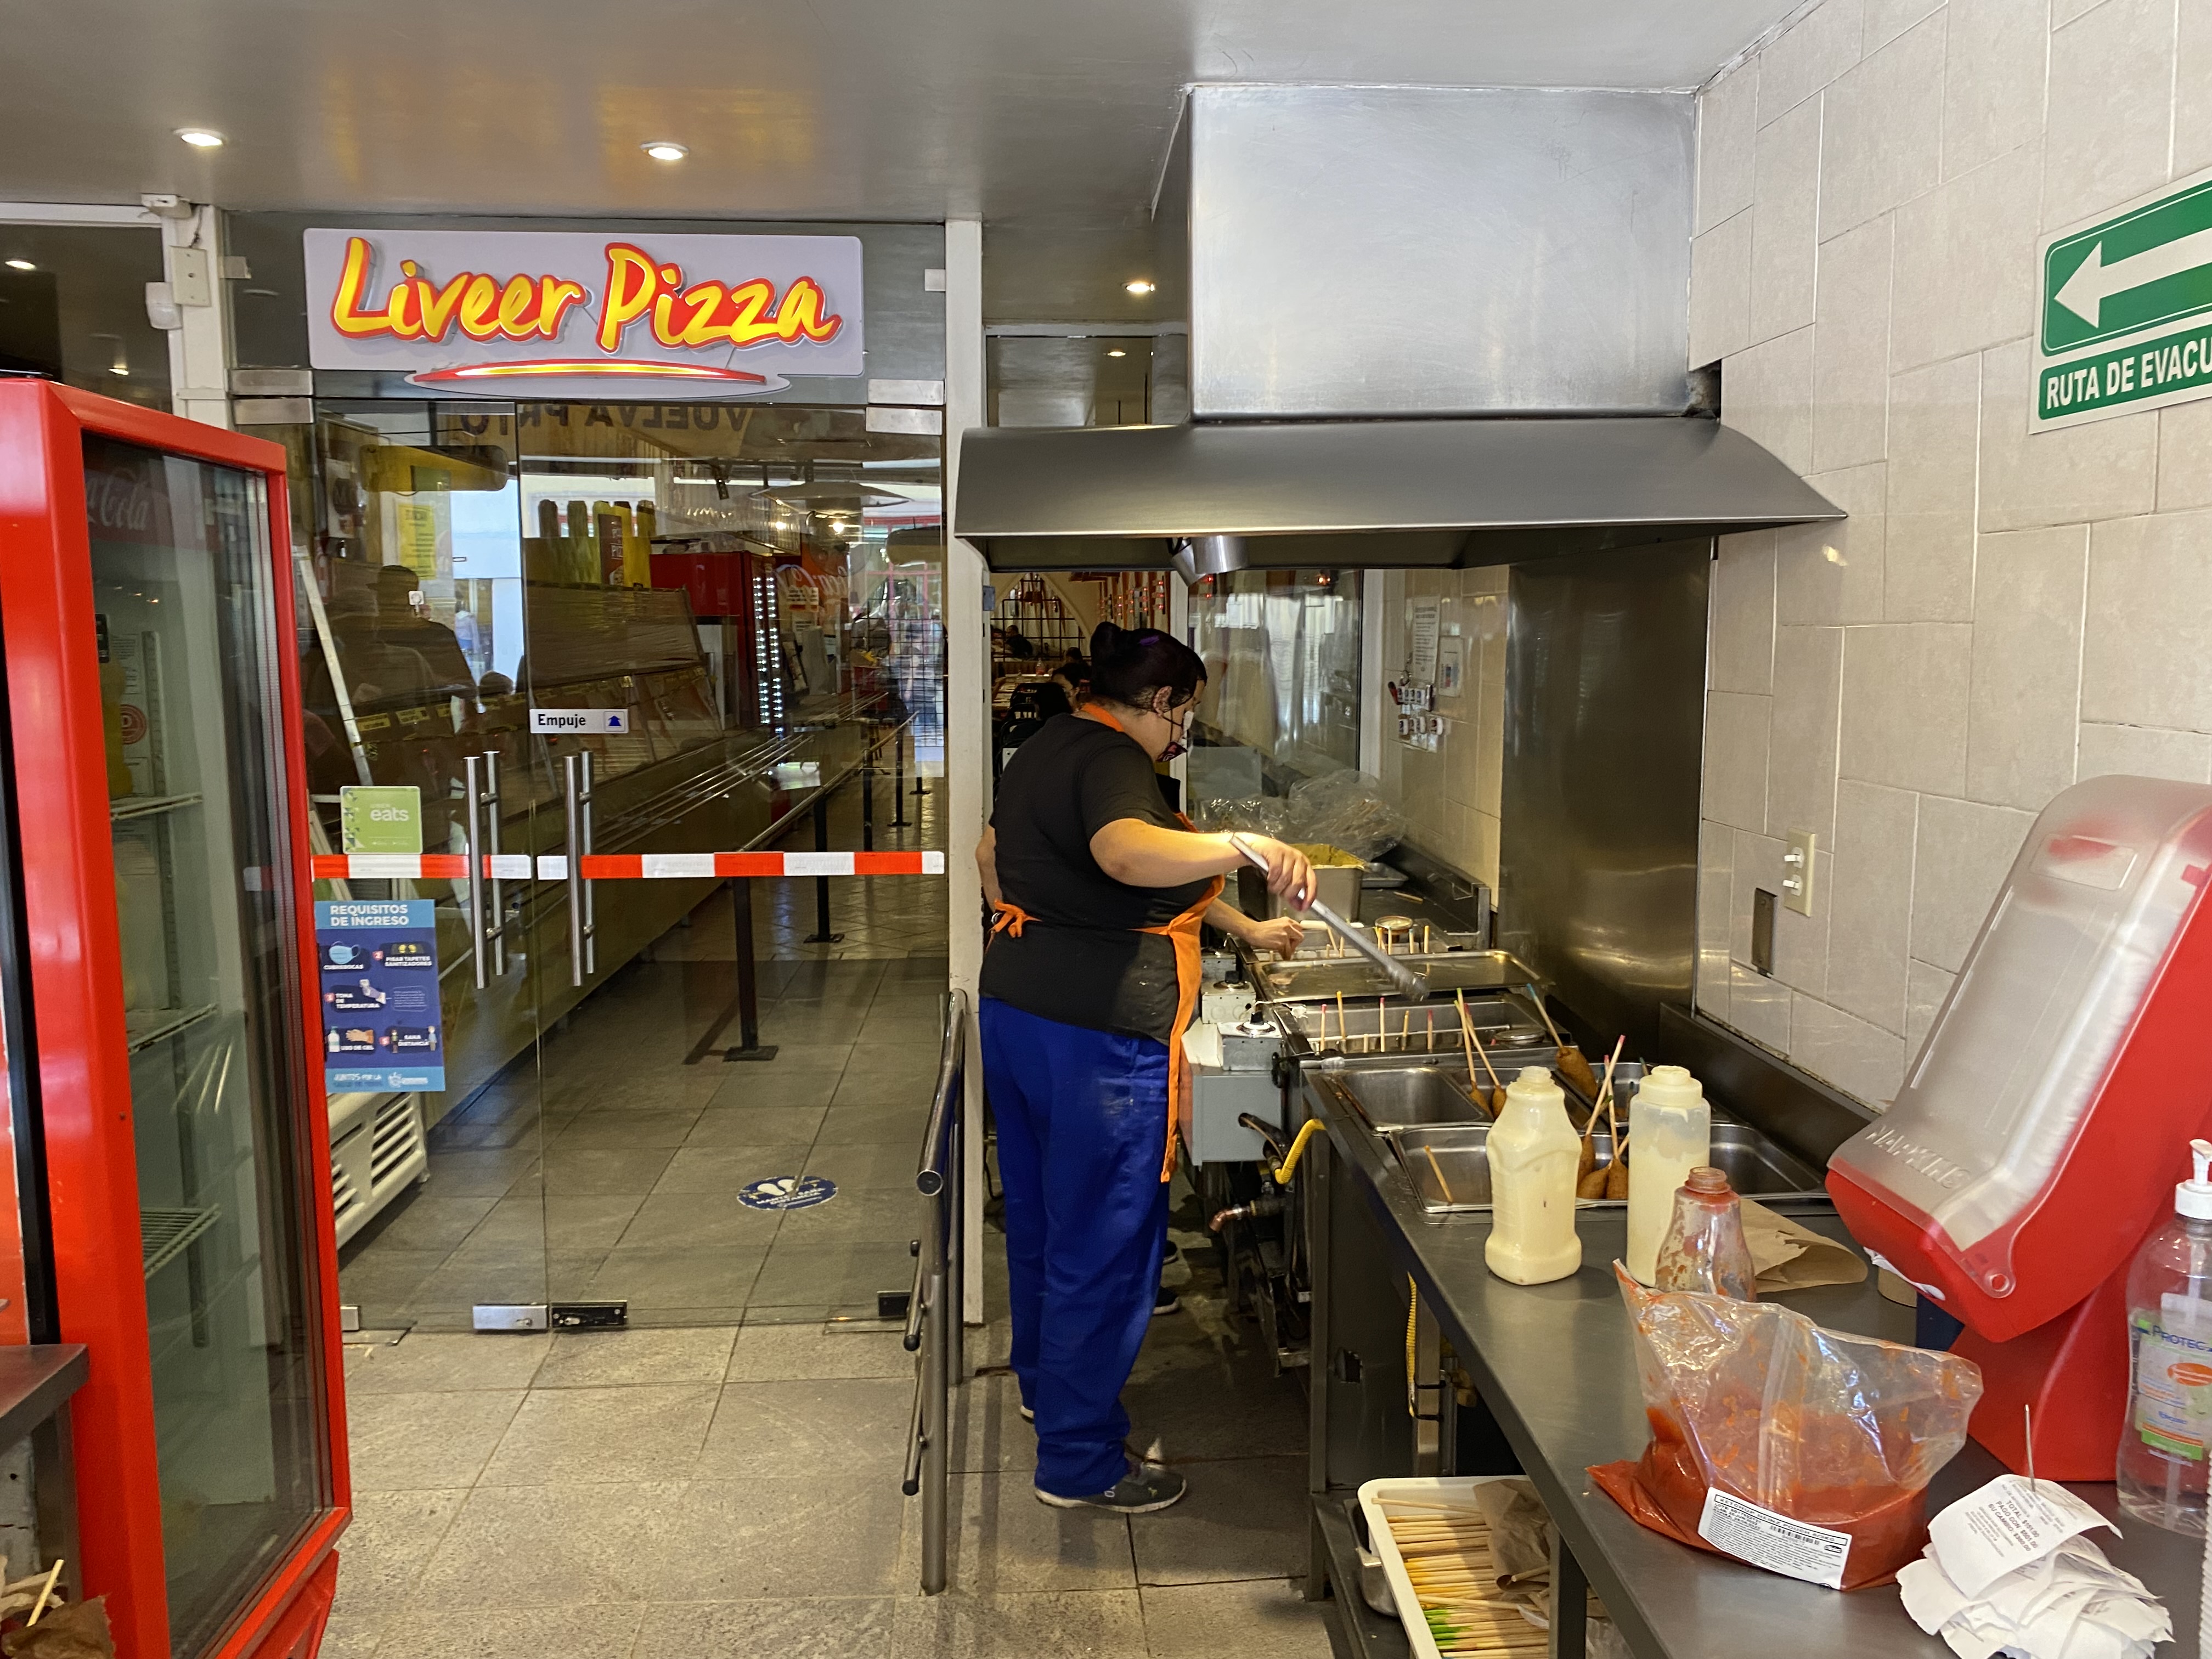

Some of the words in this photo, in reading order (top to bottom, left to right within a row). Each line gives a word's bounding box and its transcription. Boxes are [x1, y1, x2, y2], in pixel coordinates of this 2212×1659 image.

[332, 236, 586, 344] Liveer
[596, 242, 842, 354] Pizza
[2046, 366, 2100, 409] RUTA
[2106, 357, 2135, 396] DE
[538, 714, 586, 728] Empuje
[370, 807, 409, 822] eats
[330, 904, 408, 916] REQUISITOS
[330, 916, 349, 926] DE
[351, 916, 409, 926] INGRESO
[1995, 1501, 2011, 1516] PAGO
[1720, 1498, 1755, 1514] KETCHUP
[1757, 1514, 1781, 1525] HEINZ
[1783, 1523, 1810, 1535] POUCH
